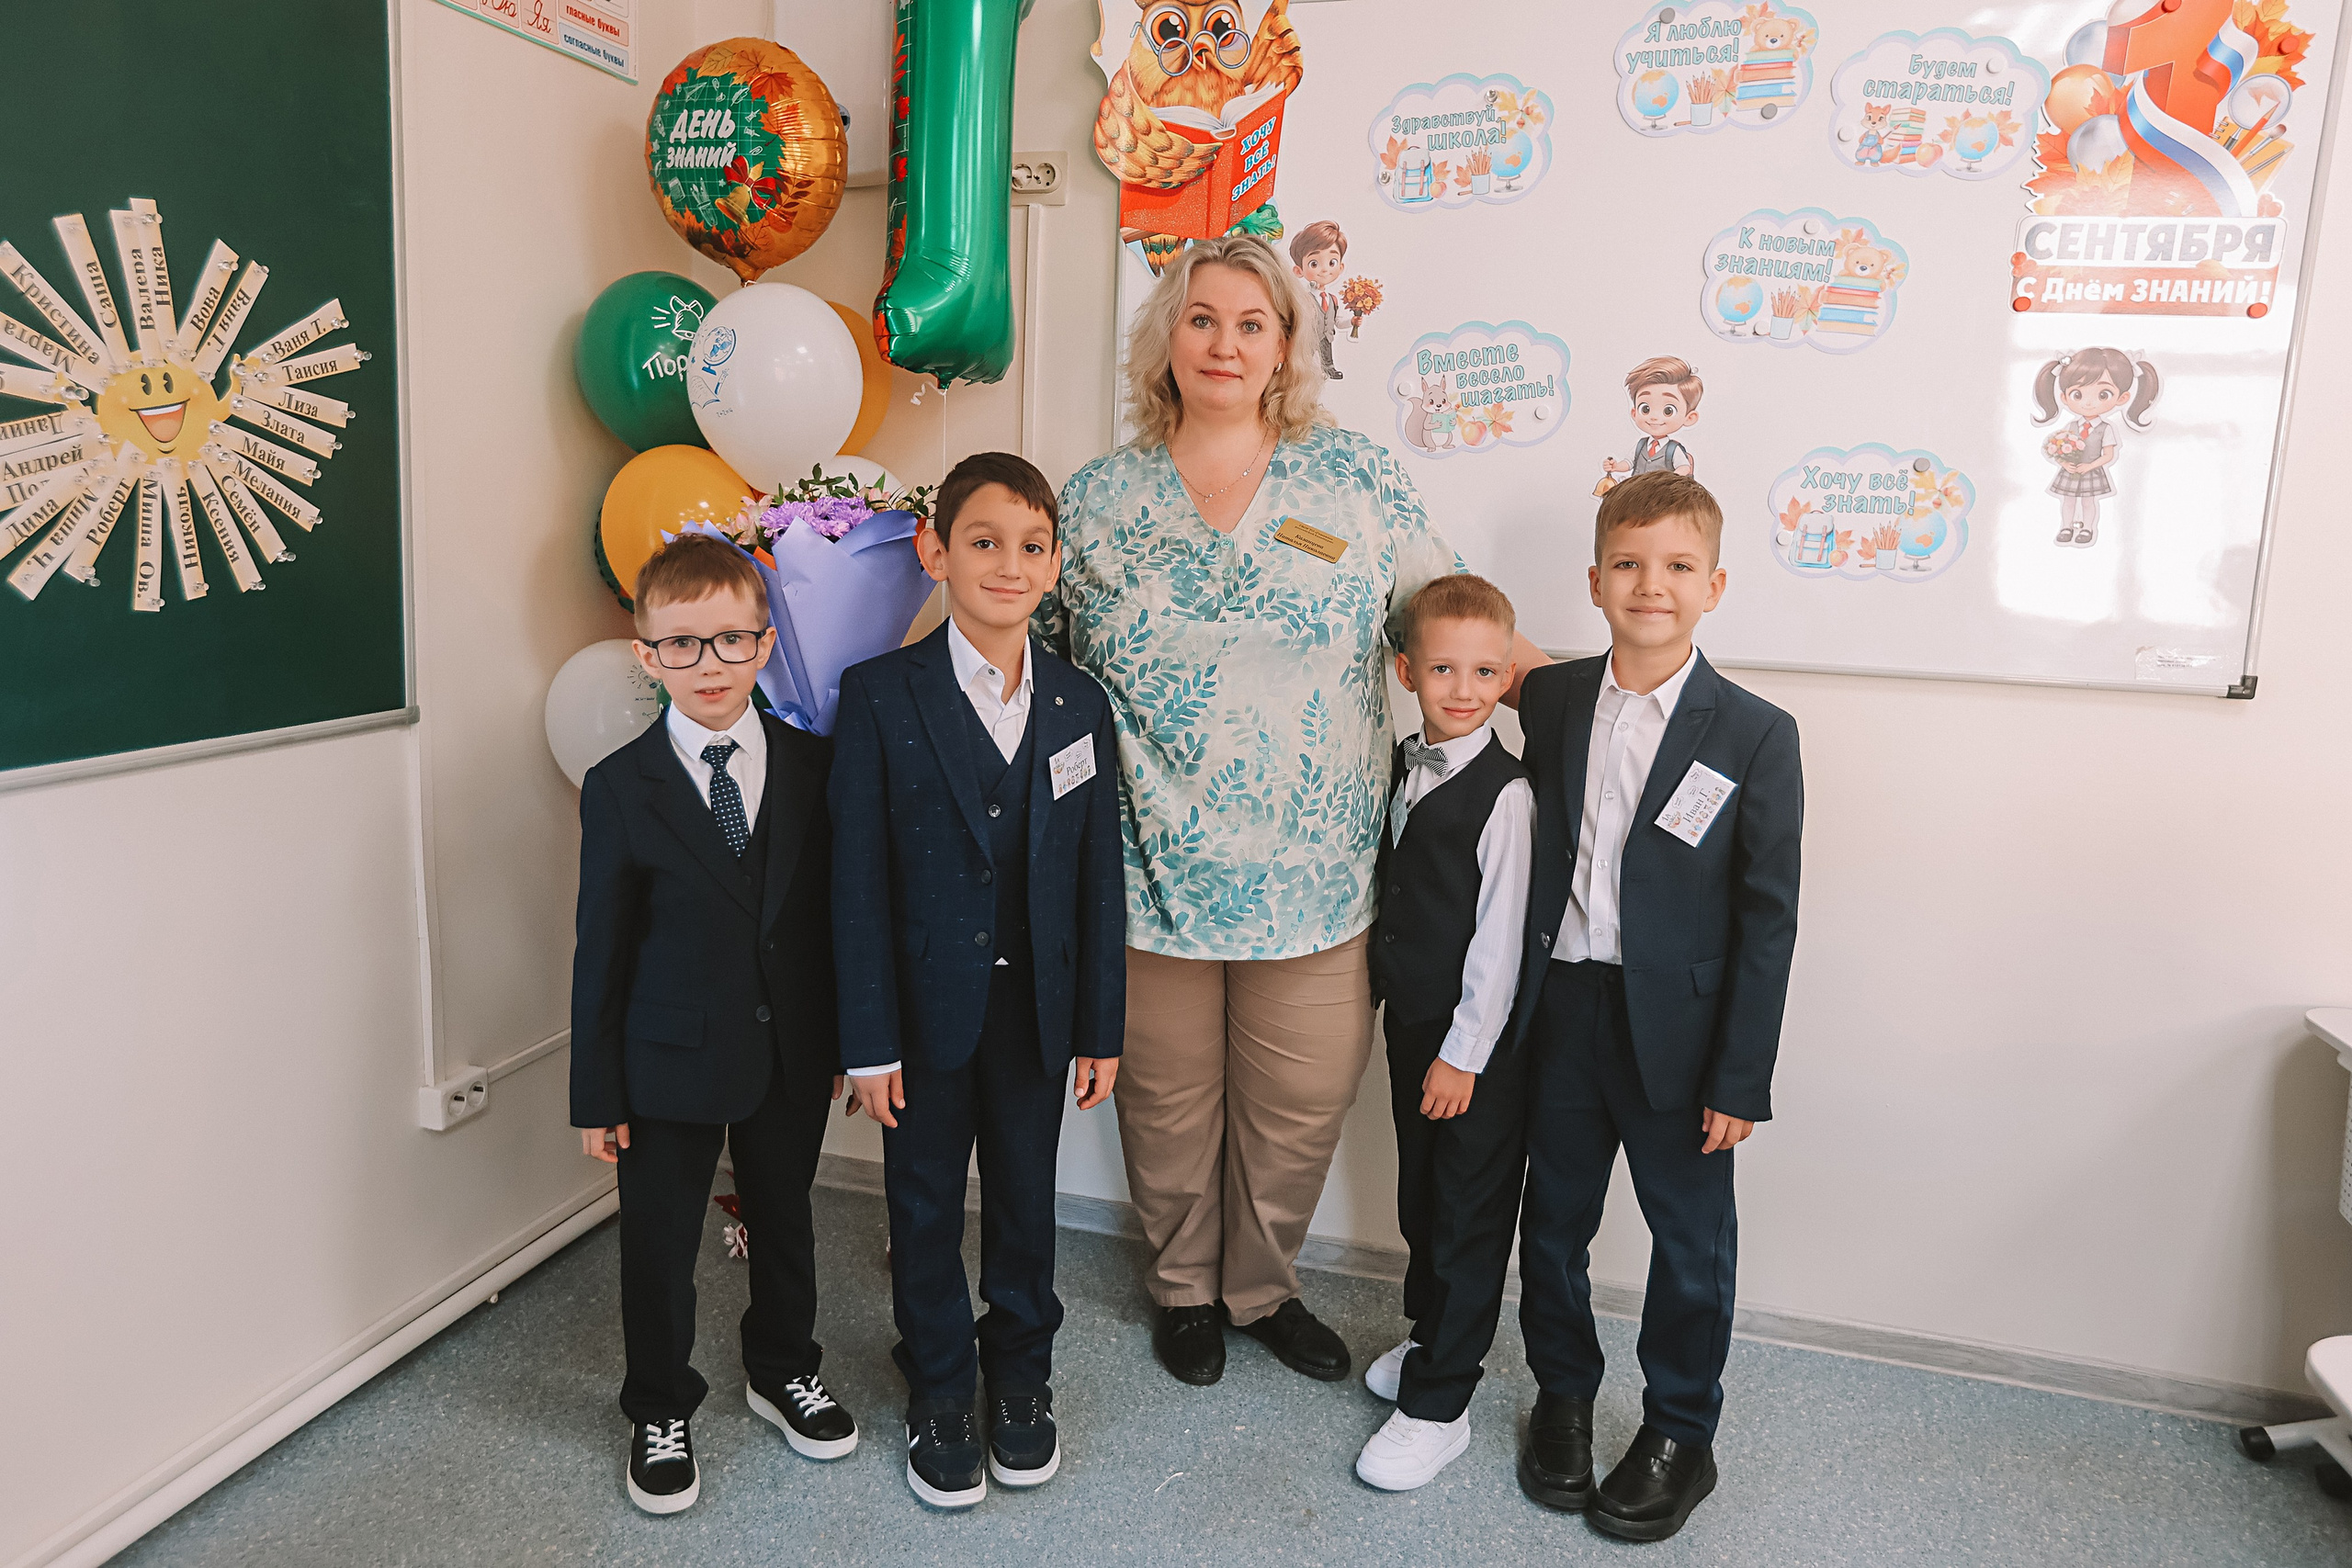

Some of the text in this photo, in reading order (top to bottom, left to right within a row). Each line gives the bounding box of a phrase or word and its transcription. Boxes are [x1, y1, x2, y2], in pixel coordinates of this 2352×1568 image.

[566, 5, 620, 38] гласные буквы
[1644, 17, 1743, 44] Я люблю
[564, 33, 625, 68] согласные буквы
[1625, 37, 1740, 73] учиться!
[1907, 53, 1977, 79] Будем
[1862, 77, 2015, 107] стараться!
[670, 108, 736, 143] ДЕНЬ
[1241, 117, 1276, 154] ХОЧУ
[1425, 117, 1508, 151] школа!
[666, 141, 737, 168] ЗНАНИЙ
[1245, 140, 1269, 172] ВСЁ
[1232, 154, 1276, 200] ЗНАТЬ!
[1737, 227, 1837, 256] К новым
[2025, 222, 2276, 263] СЕНТЯБРЯ
[153, 246, 172, 307] Ника
[1713, 253, 1834, 284] знаниям!
[86, 260, 118, 328] Саша
[132, 248, 155, 331] Валера
[2016, 276, 2272, 304] С Днём ЗНАНИЙ!
[10, 262, 100, 365] Кристина
[190, 286, 220, 333] Вова
[219, 288, 253, 333] Ваня
[4, 320, 77, 374] Марта
[271, 318, 327, 358] Ваня Т.
[282, 360, 338, 382] Таисия
[1417, 343, 1520, 376] Вместе
[1455, 365, 1525, 389] весело
[278, 391, 319, 418] Лиза
[1461, 375, 1555, 408] шагать!
[261, 411, 305, 445] Злата
[3, 444, 84, 482] Андрей
[243, 436, 286, 470] Майя
[232, 459, 302, 520] Мелания
[1801, 465, 1908, 494] Хочу всё
[86, 478, 131, 547] Роберт
[220, 475, 262, 535] Семён
[1822, 491, 1917, 515] знать!
[6, 499, 60, 547] Дима
[27, 487, 100, 569] Миша Ч.
[137, 478, 159, 598] Миша Ов.
[176, 485, 201, 570] Николь
[201, 491, 240, 564] Ксения
[1066, 758, 1088, 776] Роберт
[1682, 798, 1704, 823] Иван
